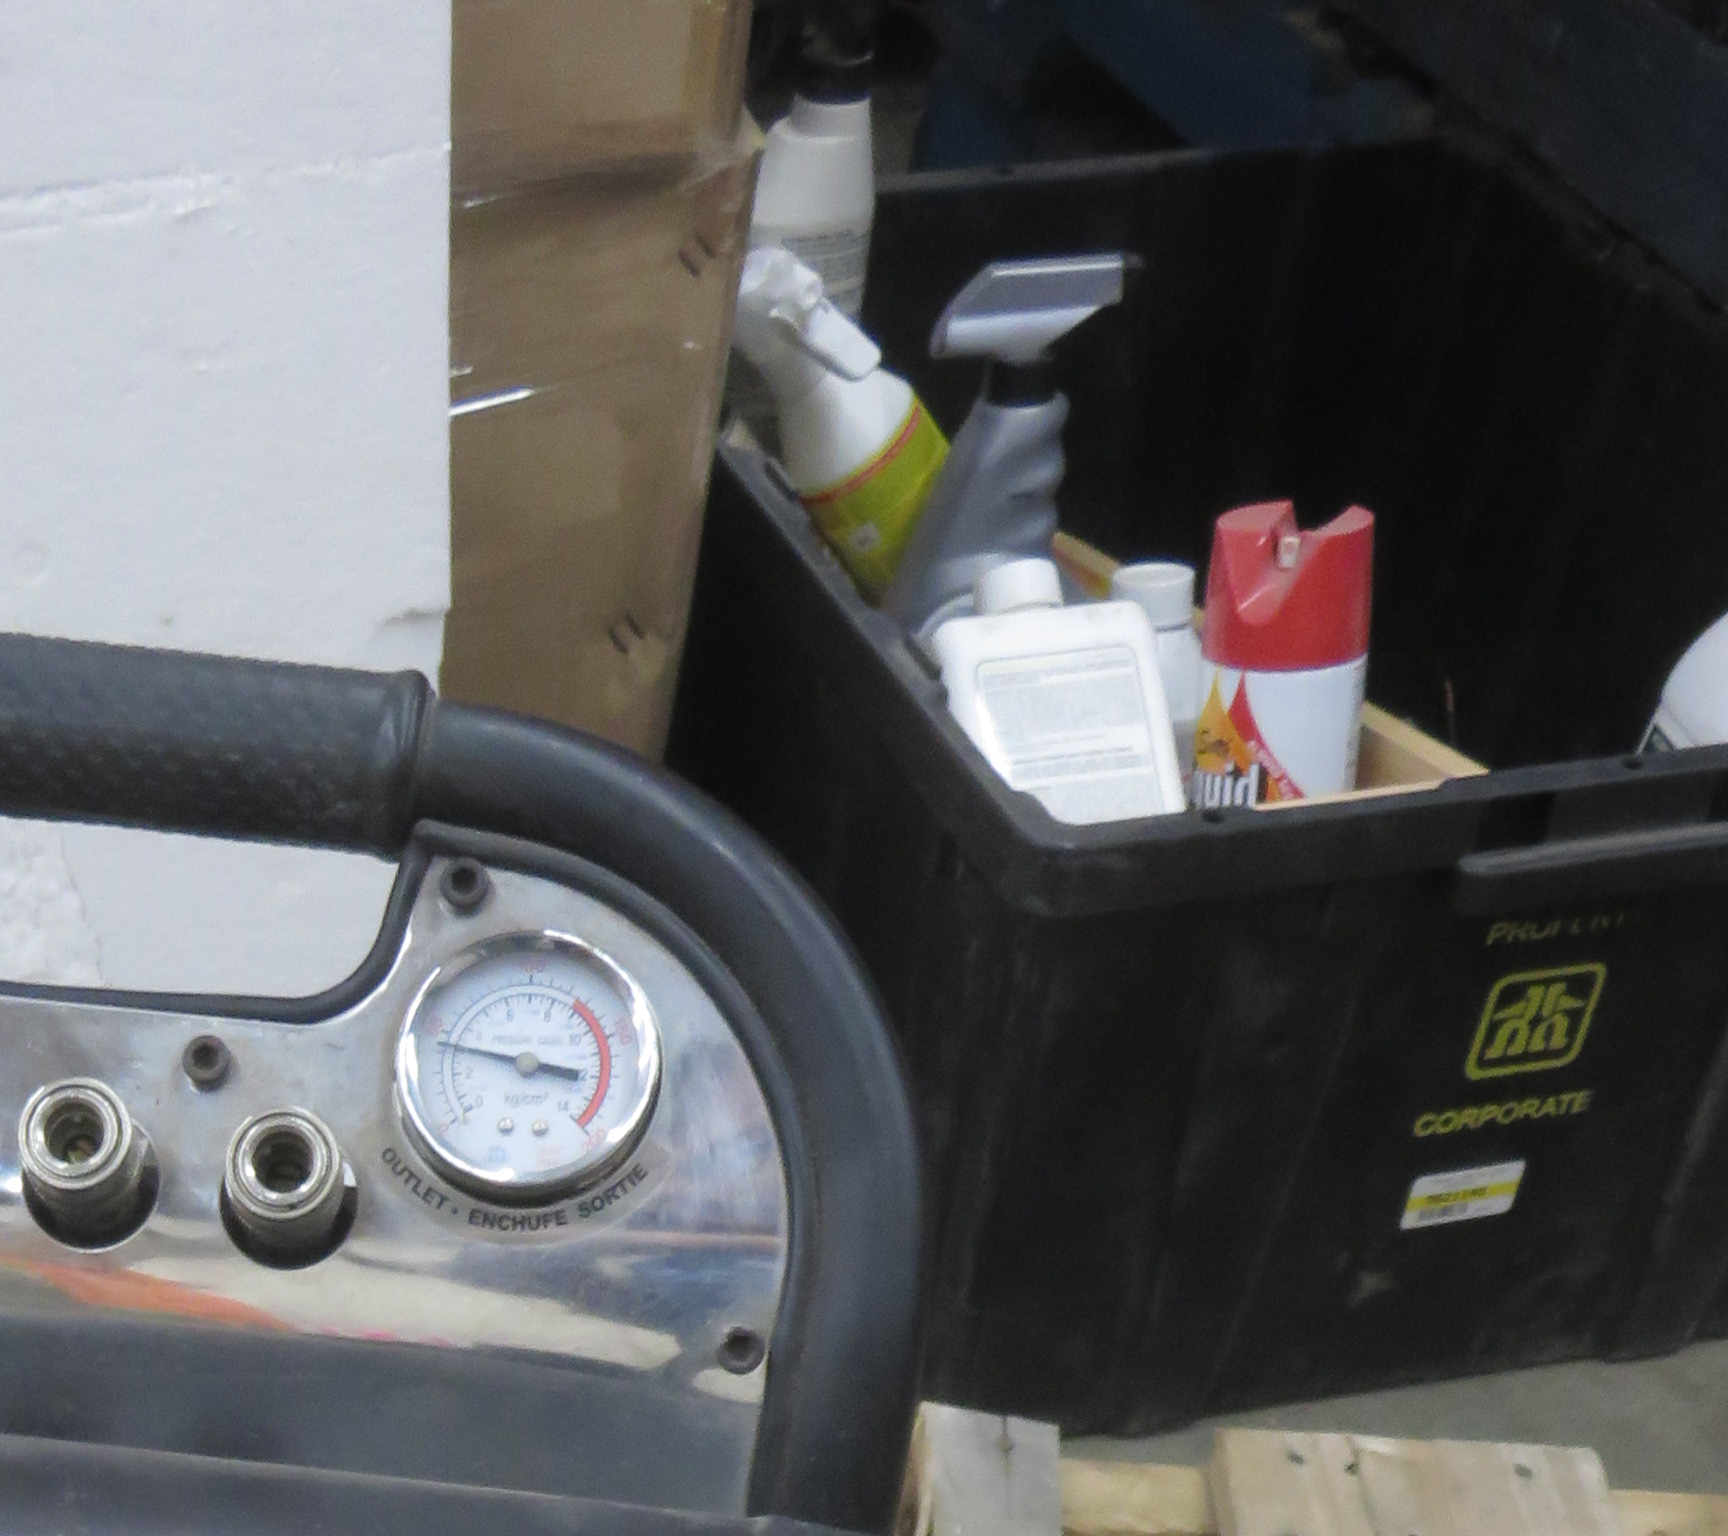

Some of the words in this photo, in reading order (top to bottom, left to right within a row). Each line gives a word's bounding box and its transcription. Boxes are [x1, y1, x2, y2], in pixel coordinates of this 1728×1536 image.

[1414, 1090, 1594, 1137] CORPORATE
[380, 1147, 451, 1210] OUTLET
[468, 1208, 569, 1232] ENCHUFE
[577, 1162, 649, 1219] SORTIE
